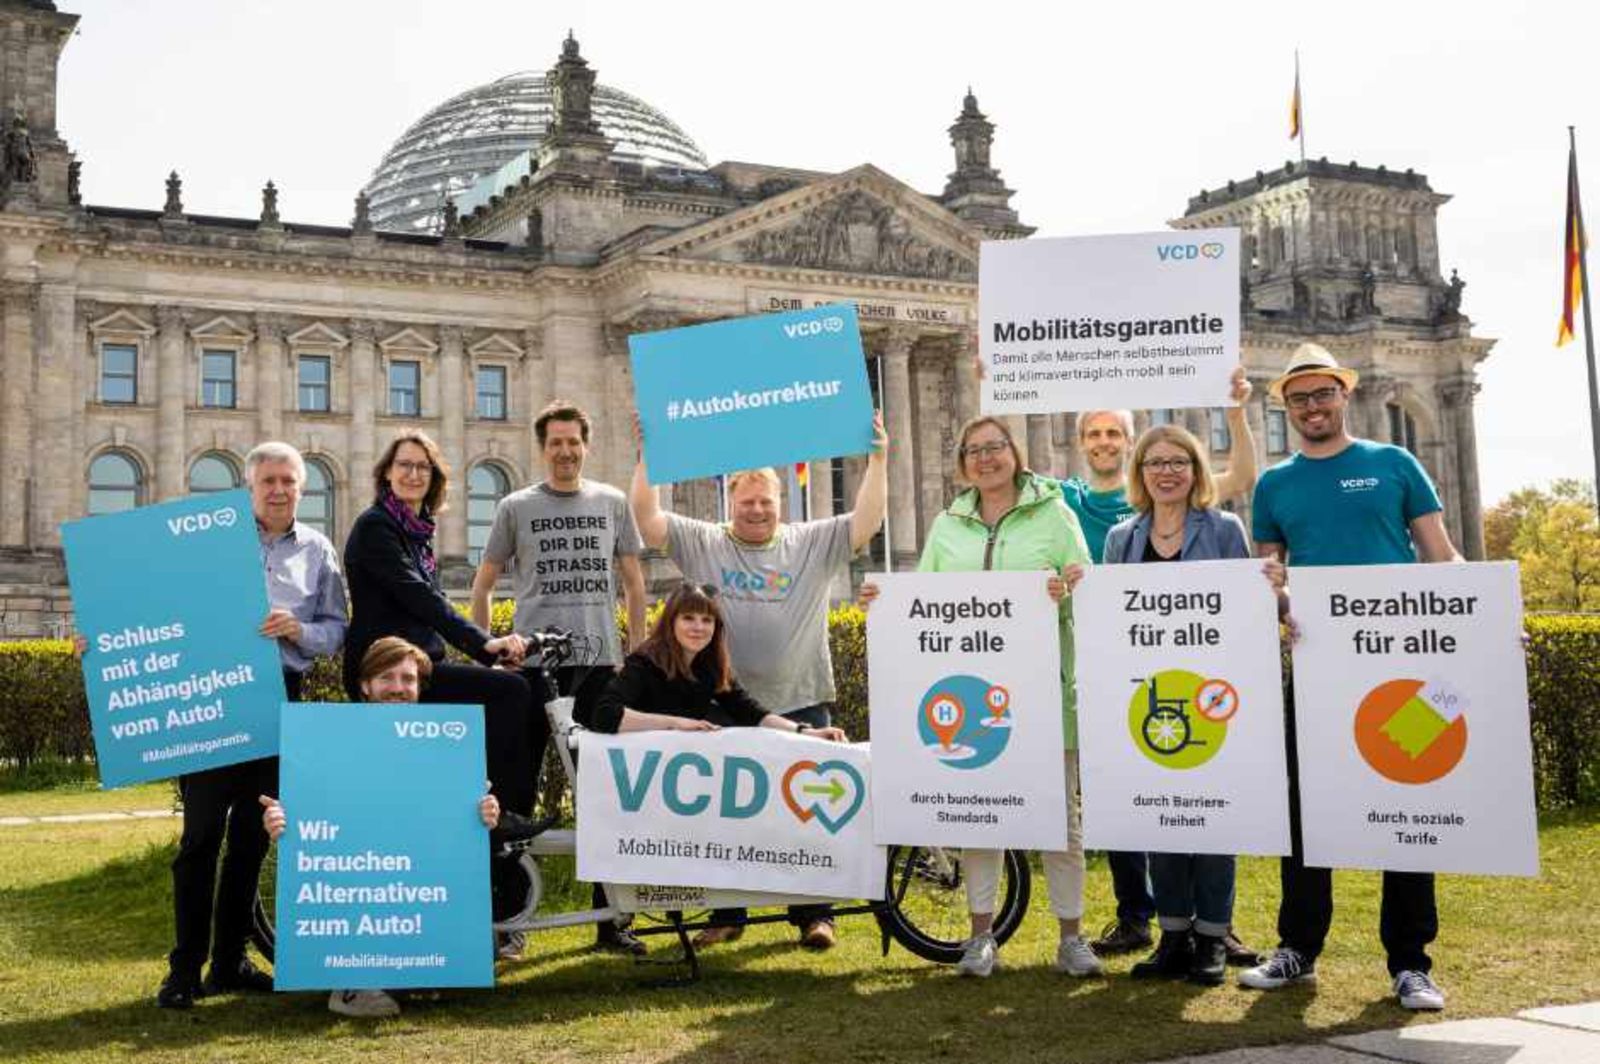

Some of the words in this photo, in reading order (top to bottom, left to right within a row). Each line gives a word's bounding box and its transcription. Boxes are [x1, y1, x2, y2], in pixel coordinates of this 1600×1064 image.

[1157, 244, 1198, 261] VCD
[906, 308, 948, 321] VOLKE
[783, 320, 821, 338] VCD
[993, 313, 1223, 343] Mobilitätsgarantie
[993, 353, 1028, 365] Damit
[1031, 352, 1052, 364] alle
[1056, 347, 1120, 362] Menschen
[1123, 345, 1224, 359] selbstbestimmt
[993, 371, 1015, 382] und
[1019, 365, 1122, 382] klimaverträglich
[1126, 364, 1163, 378] mobil
[1168, 364, 1196, 376] sein
[667, 379, 842, 421] #Autokorrektur
[1340, 479, 1364, 488] VCD
[167, 513, 212, 536] VCD
[531, 516, 607, 533] EROBERE
[540, 537, 569, 552] DIR
[573, 535, 600, 550] DIE
[536, 558, 608, 575] STRASSE
[541, 576, 609, 595] ZURÜCK!
[909, 596, 1013, 624] Angebot
[1124, 590, 1222, 616] Zugang
[1330, 591, 1477, 617] Bezahlbar
[97, 622, 185, 652] Schluss
[918, 631, 953, 653] für
[961, 631, 1005, 653] alle
[1128, 624, 1165, 646] für
[1174, 623, 1220, 646] alle
[1353, 630, 1394, 654] für
[1404, 629, 1456, 654] alle
[101, 657, 139, 682] mit
[144, 651, 181, 673] der
[107, 664, 255, 711] Abhängigkeit
[111, 718, 159, 740] vom
[166, 700, 224, 730] Auto!
[939, 706, 952, 721] H
[394, 721, 440, 738] VCD
[142, 732, 250, 763] #Mobilitätsgarantie
[606, 747, 770, 819] VCD
[910, 792, 945, 805] durch
[947, 793, 1025, 807] bundesweite
[1133, 795, 1169, 807] durch
[1173, 796, 1230, 808] Barriere-
[937, 811, 998, 824] Standards
[1160, 814, 1206, 827] freiheit
[1367, 810, 1407, 824] durch
[1412, 812, 1464, 826] soziale
[298, 821, 339, 841] Wir
[1395, 832, 1438, 846] Tarife
[618, 838, 700, 858] Mobilität
[703, 842, 732, 861] für
[297, 851, 411, 872] brauchen
[296, 883, 448, 904] Alternativen
[296, 919, 349, 936] zum
[357, 915, 422, 935] Auto!
[324, 954, 446, 970] #Mobilitätsgarantie
